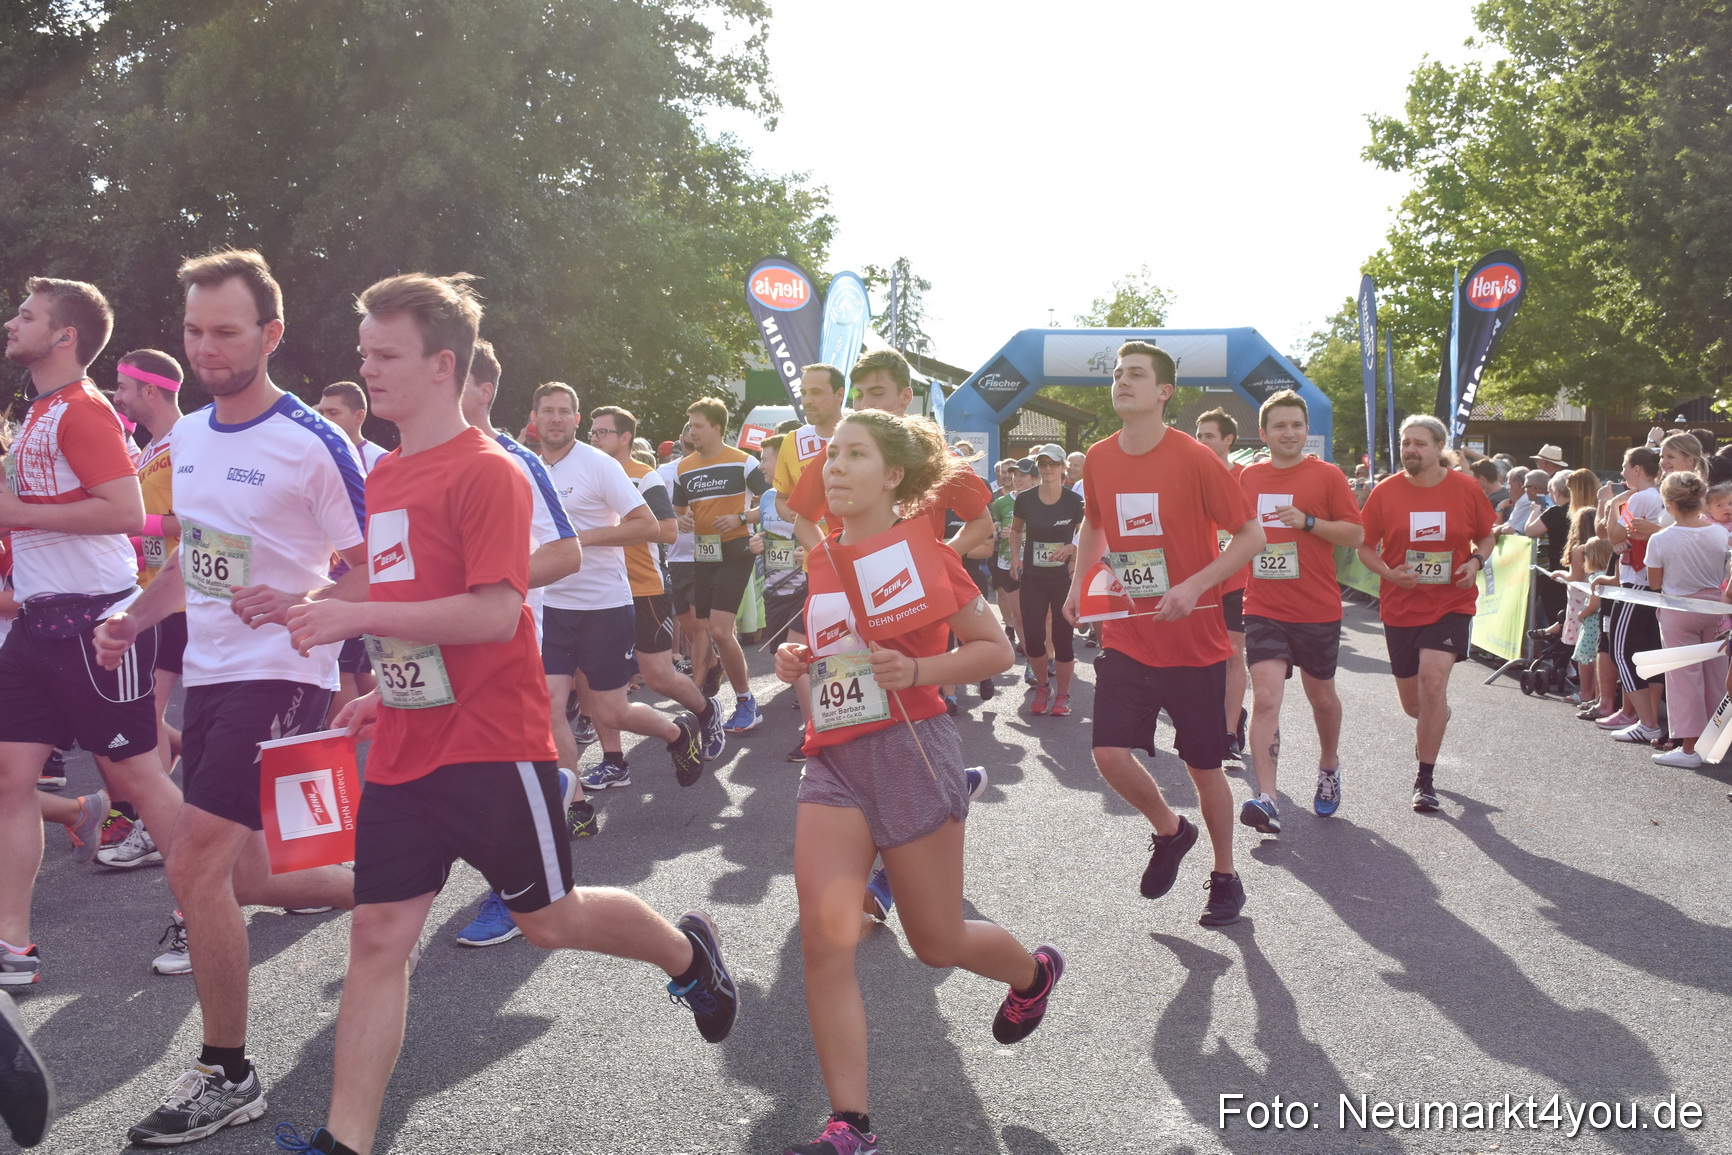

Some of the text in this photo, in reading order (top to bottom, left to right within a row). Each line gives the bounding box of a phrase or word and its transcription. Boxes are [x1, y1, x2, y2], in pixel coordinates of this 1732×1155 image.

[1472, 275, 1517, 300] Hervis
[984, 378, 1021, 388] Fischer
[177, 465, 194, 474] JAKO
[226, 467, 266, 487] GOSSNER
[692, 478, 729, 489] Fischer
[698, 544, 715, 555] 790
[767, 550, 790, 562] 1947
[192, 549, 229, 581] 936
[1260, 556, 1287, 570] 522
[1414, 563, 1442, 576] 479
[1123, 566, 1155, 585] 464
[884, 578, 902, 598] DEHN
[868, 602, 930, 628] DEHN protects.
[380, 661, 426, 689] 532
[820, 677, 865, 710] 494
[283, 687, 305, 729] 2XU
[821, 704, 866, 719] Hauer Barbara
[107, 739, 130, 749] adidas
[308, 792, 324, 814] DEHN
[338, 765, 354, 831] DEHN protects.
